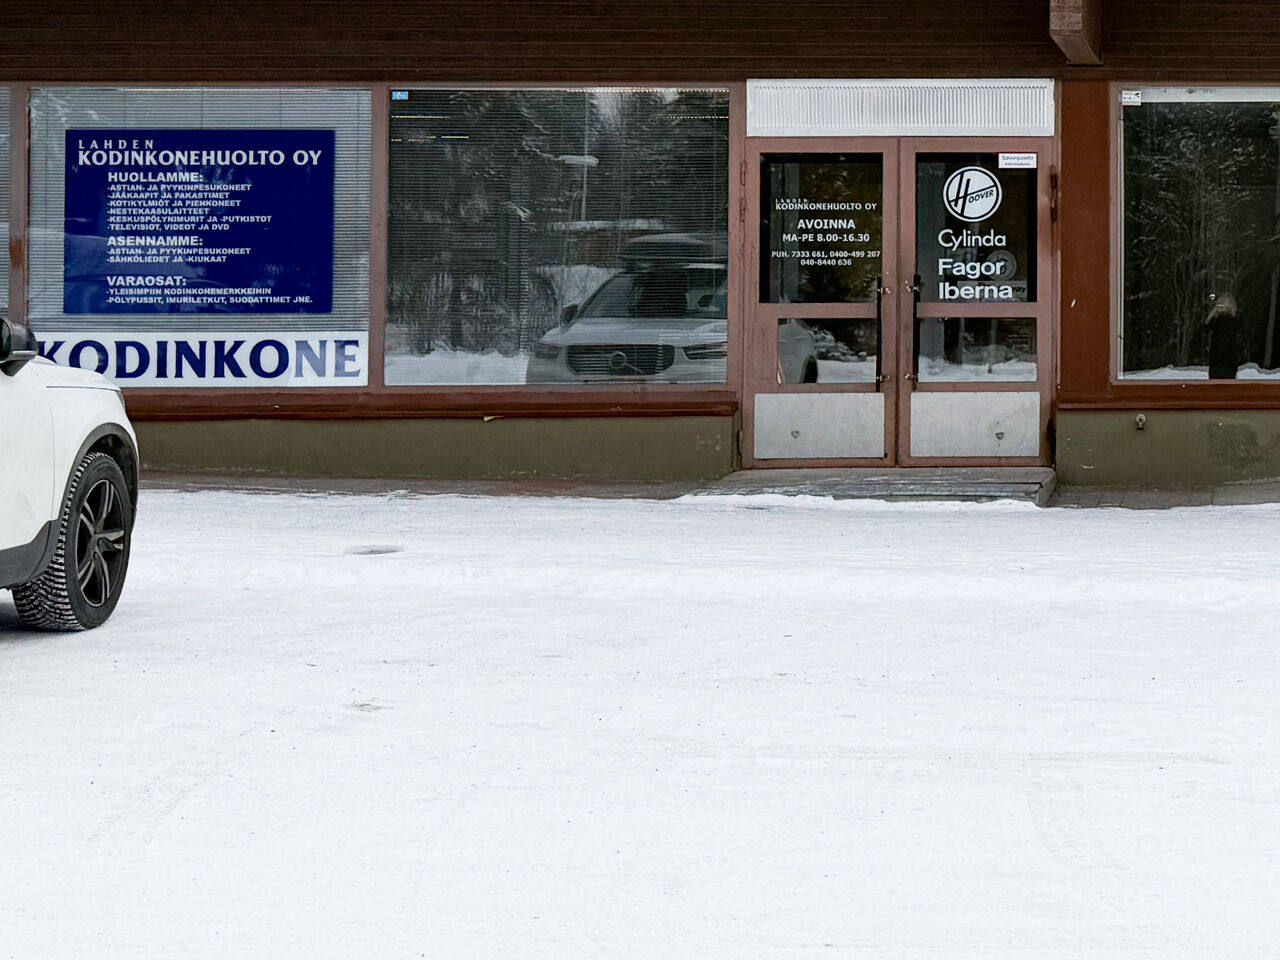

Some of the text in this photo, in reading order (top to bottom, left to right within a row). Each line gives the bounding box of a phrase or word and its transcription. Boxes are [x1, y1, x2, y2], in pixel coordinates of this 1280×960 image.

[78, 139, 153, 149] LAHDEN
[78, 150, 322, 166] KODINKONEHUOLTO OY
[108, 172, 204, 182] HUOLLAMME:
[775, 203, 862, 211] KODINKONEHUOLTO
[797, 219, 856, 229] AVOINNA
[107, 236, 203, 246] ASENNAMME:
[782, 234, 870, 242] MA-PE 8.00-16.30
[938, 229, 1006, 251] Cylinda
[938, 258, 1004, 279] Fagor
[106, 276, 187, 286] VARAOSAT:
[939, 282, 1013, 299] Iberna
